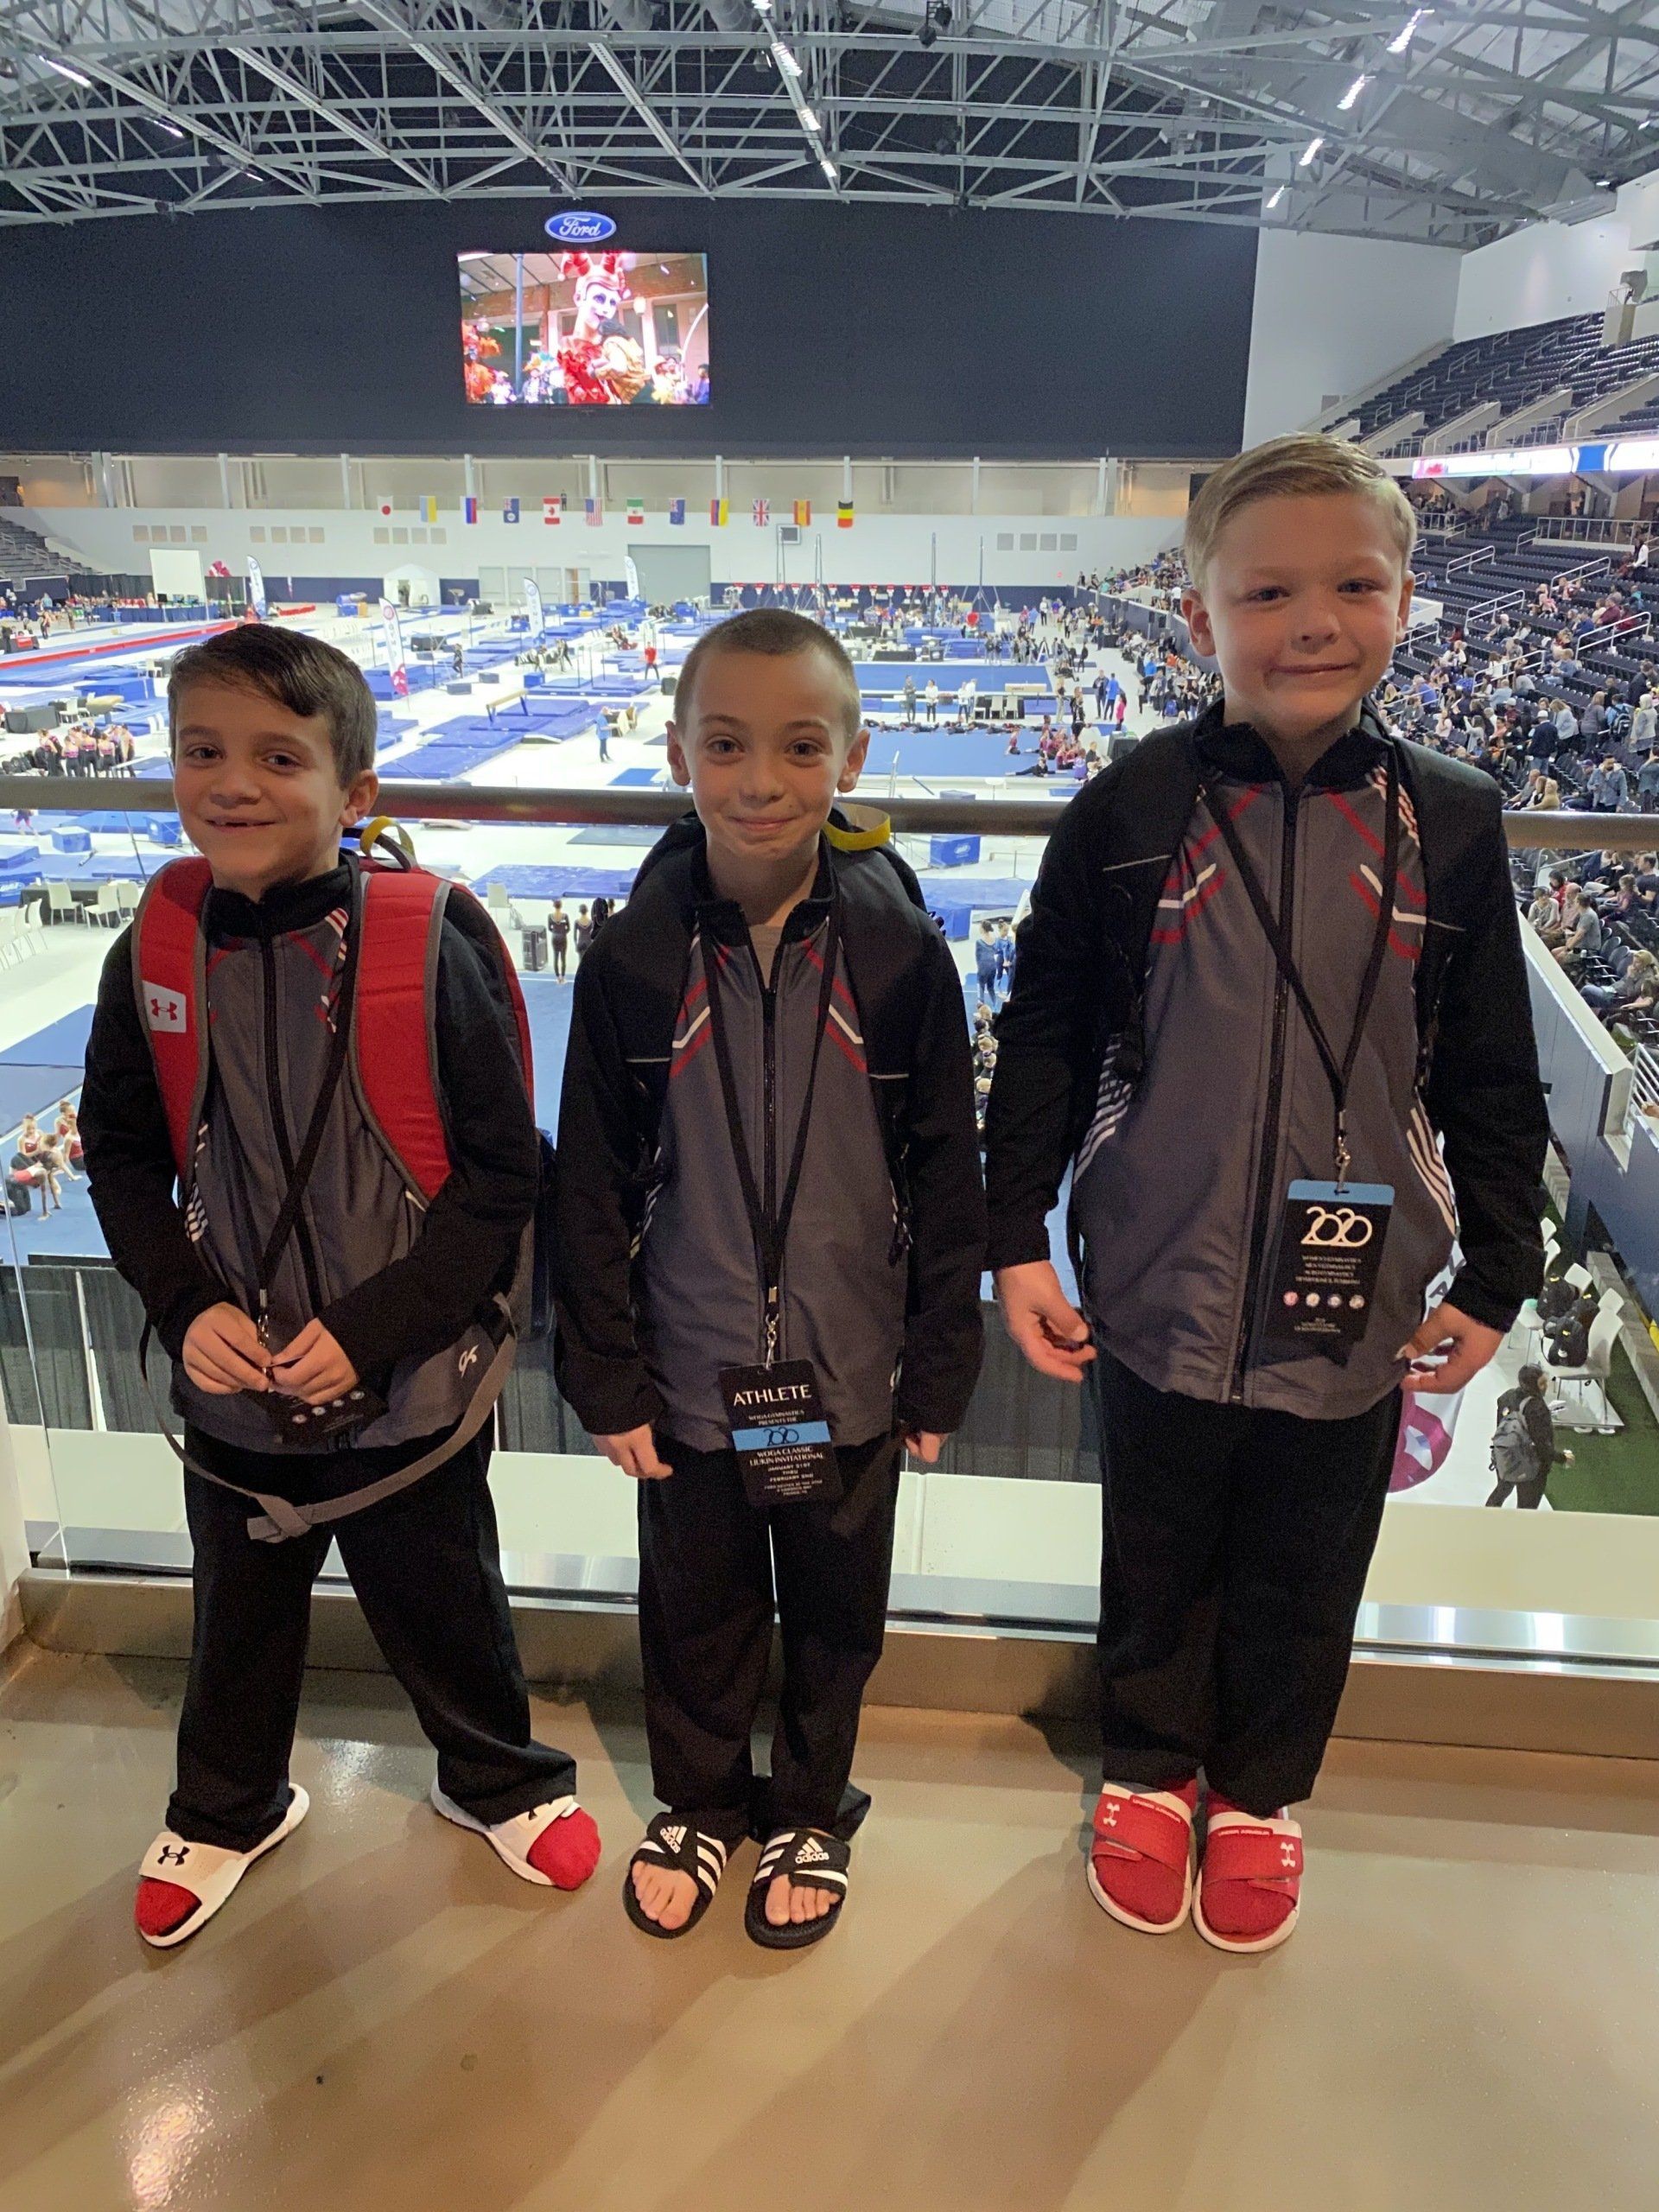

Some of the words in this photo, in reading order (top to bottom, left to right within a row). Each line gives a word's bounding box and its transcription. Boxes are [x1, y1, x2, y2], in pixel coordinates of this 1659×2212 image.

[559, 216, 601, 237] Ford
[734, 1384, 812, 1407] ATHLETE
[757, 1449, 781, 1458] WOGA
[782, 1446, 813, 1456] CLASSIC
[775, 1452, 823, 1463] INVITATIONAL
[659, 1827, 681, 1853] adidas
[795, 1852, 830, 1864] adidas
